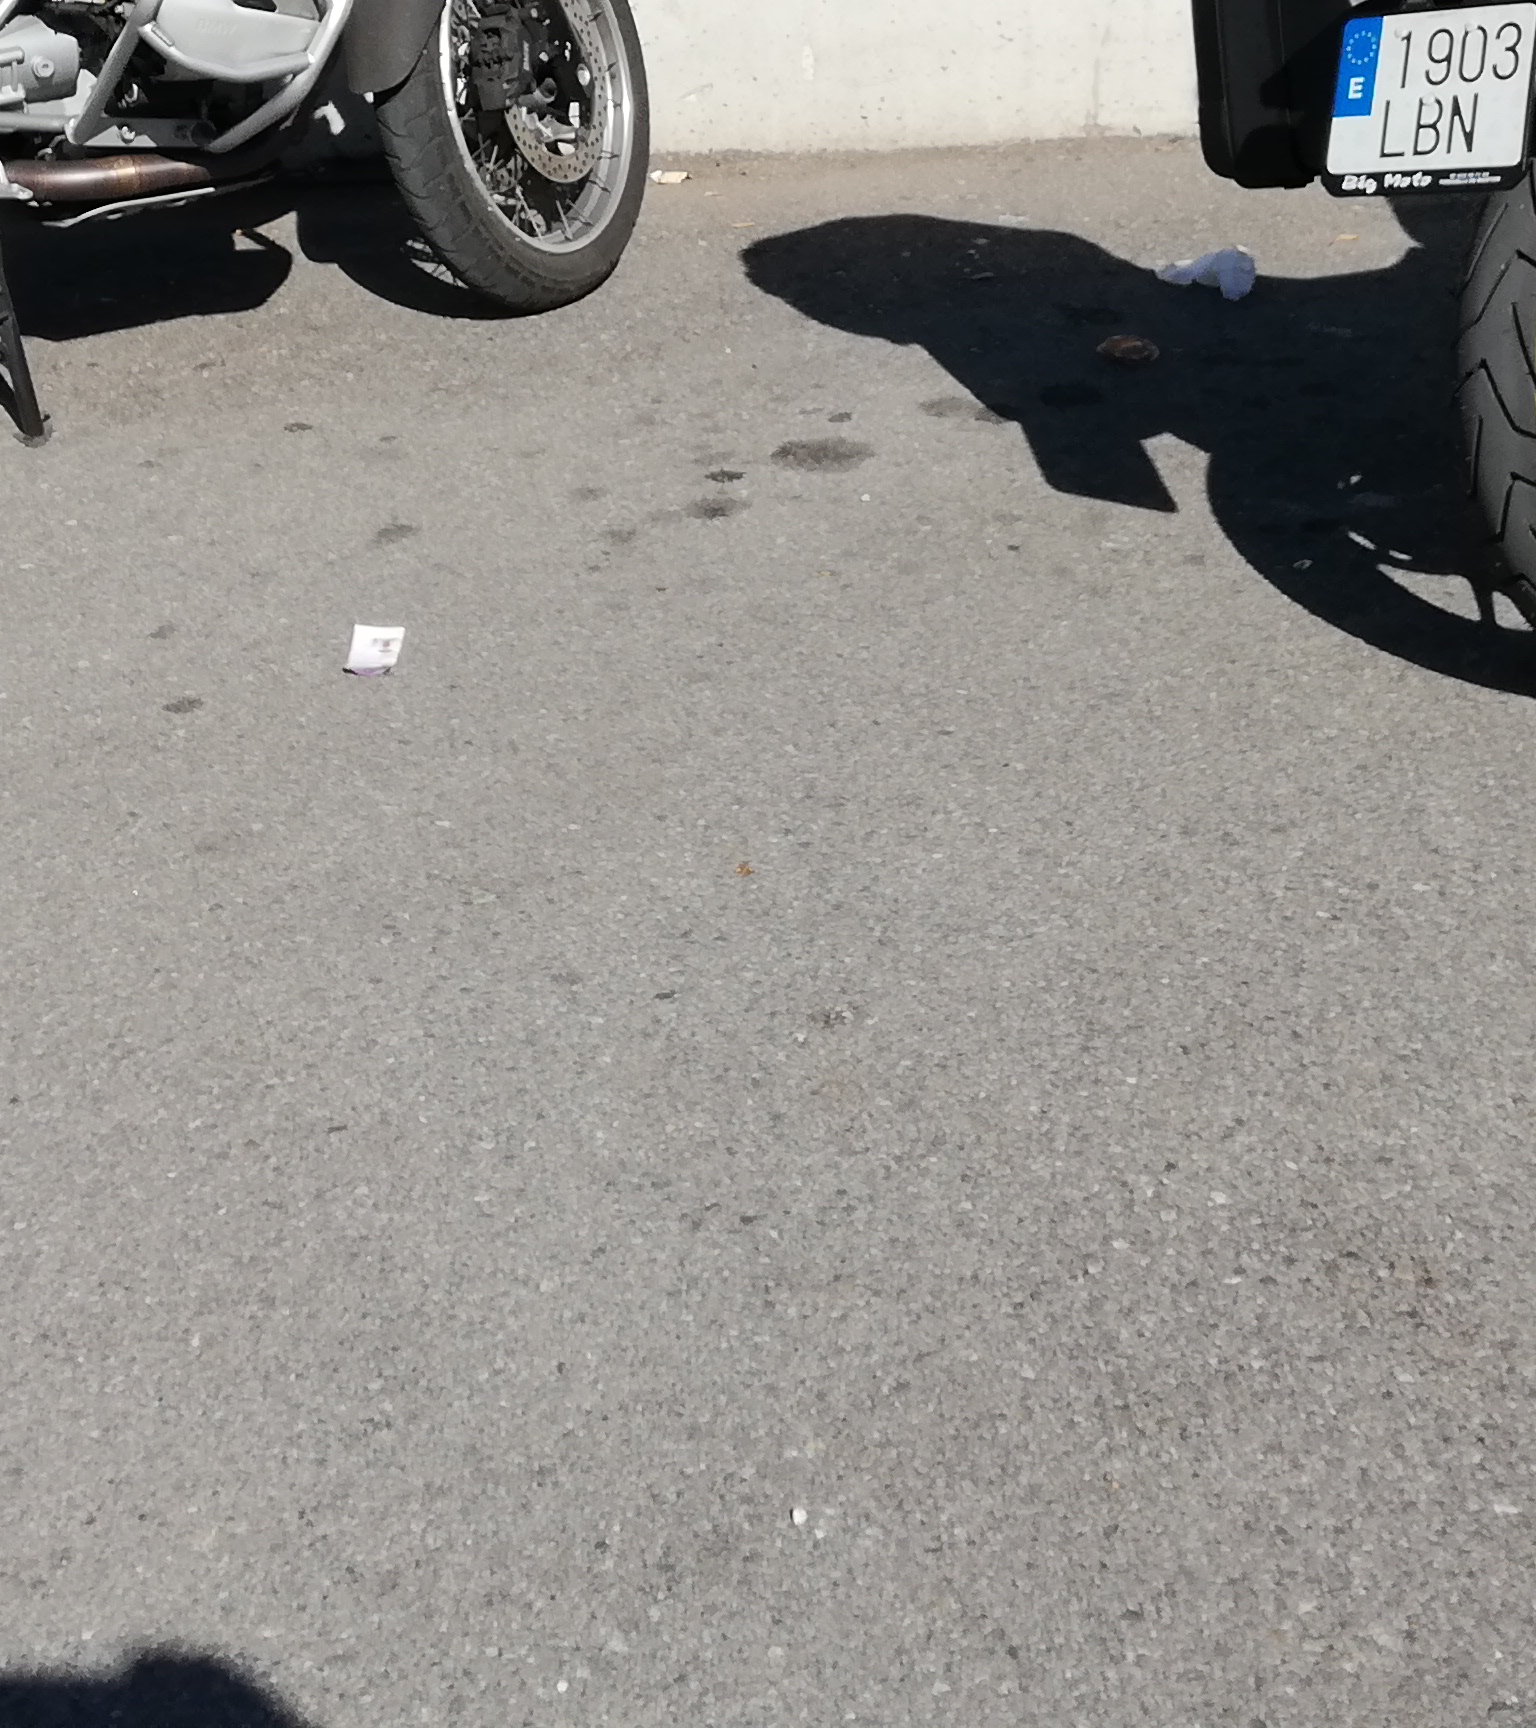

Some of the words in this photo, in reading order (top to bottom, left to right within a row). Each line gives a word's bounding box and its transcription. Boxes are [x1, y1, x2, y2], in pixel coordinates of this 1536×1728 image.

[1394, 21, 1522, 89] 1903
[1347, 76, 1365, 100] E
[1379, 92, 1479, 159] LBN
[1341, 175, 1378, 195] Big
[1383, 171, 1433, 189] Moto
